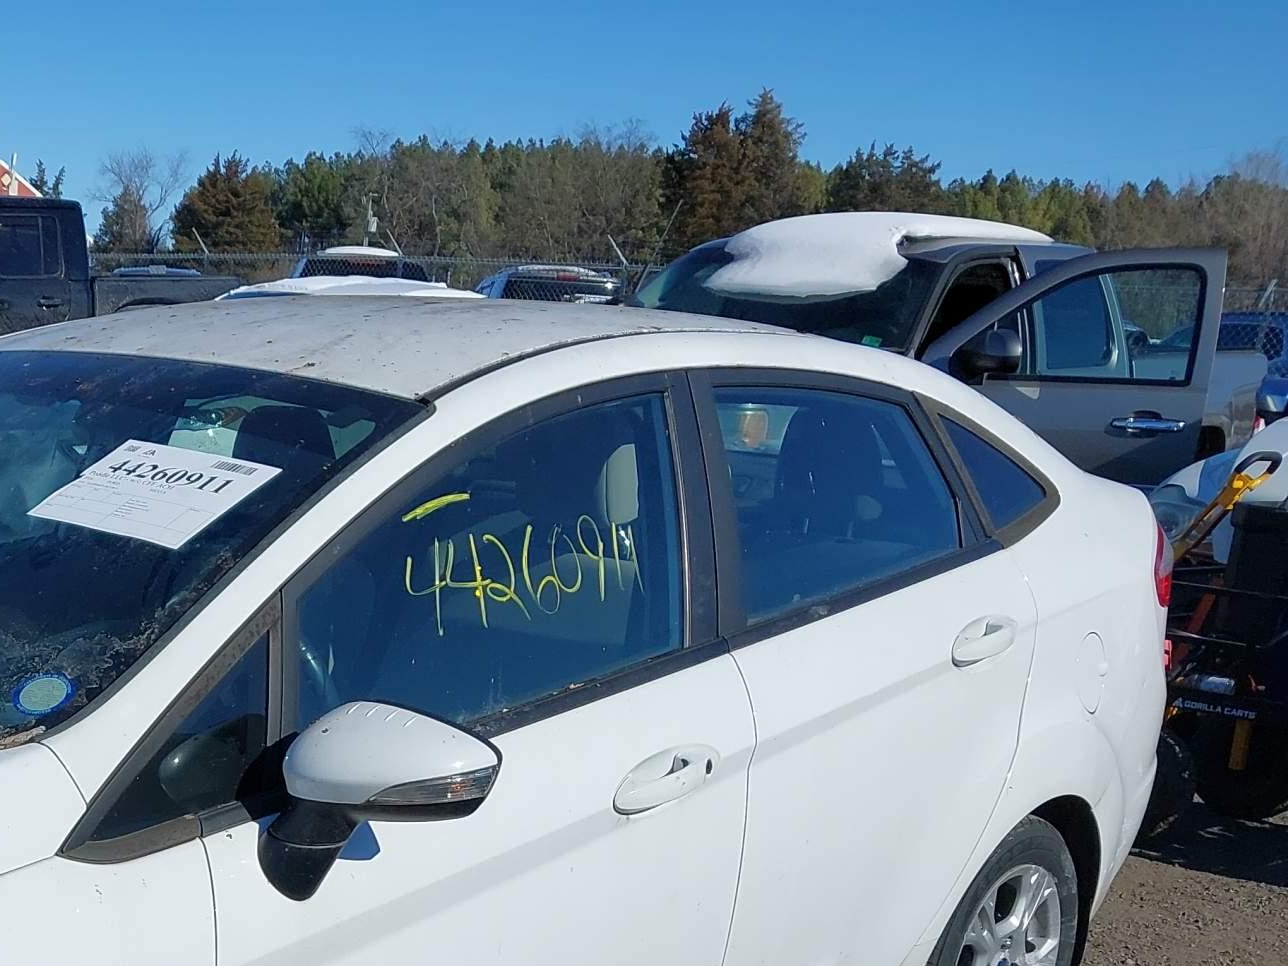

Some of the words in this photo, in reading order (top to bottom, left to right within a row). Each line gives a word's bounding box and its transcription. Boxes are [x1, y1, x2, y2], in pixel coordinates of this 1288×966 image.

[108, 459, 235, 494] 44260911
[404, 514, 645, 636] 44260911
[1183, 700, 1222, 713] GORILLA
[1223, 707, 1257, 719] CARTS
